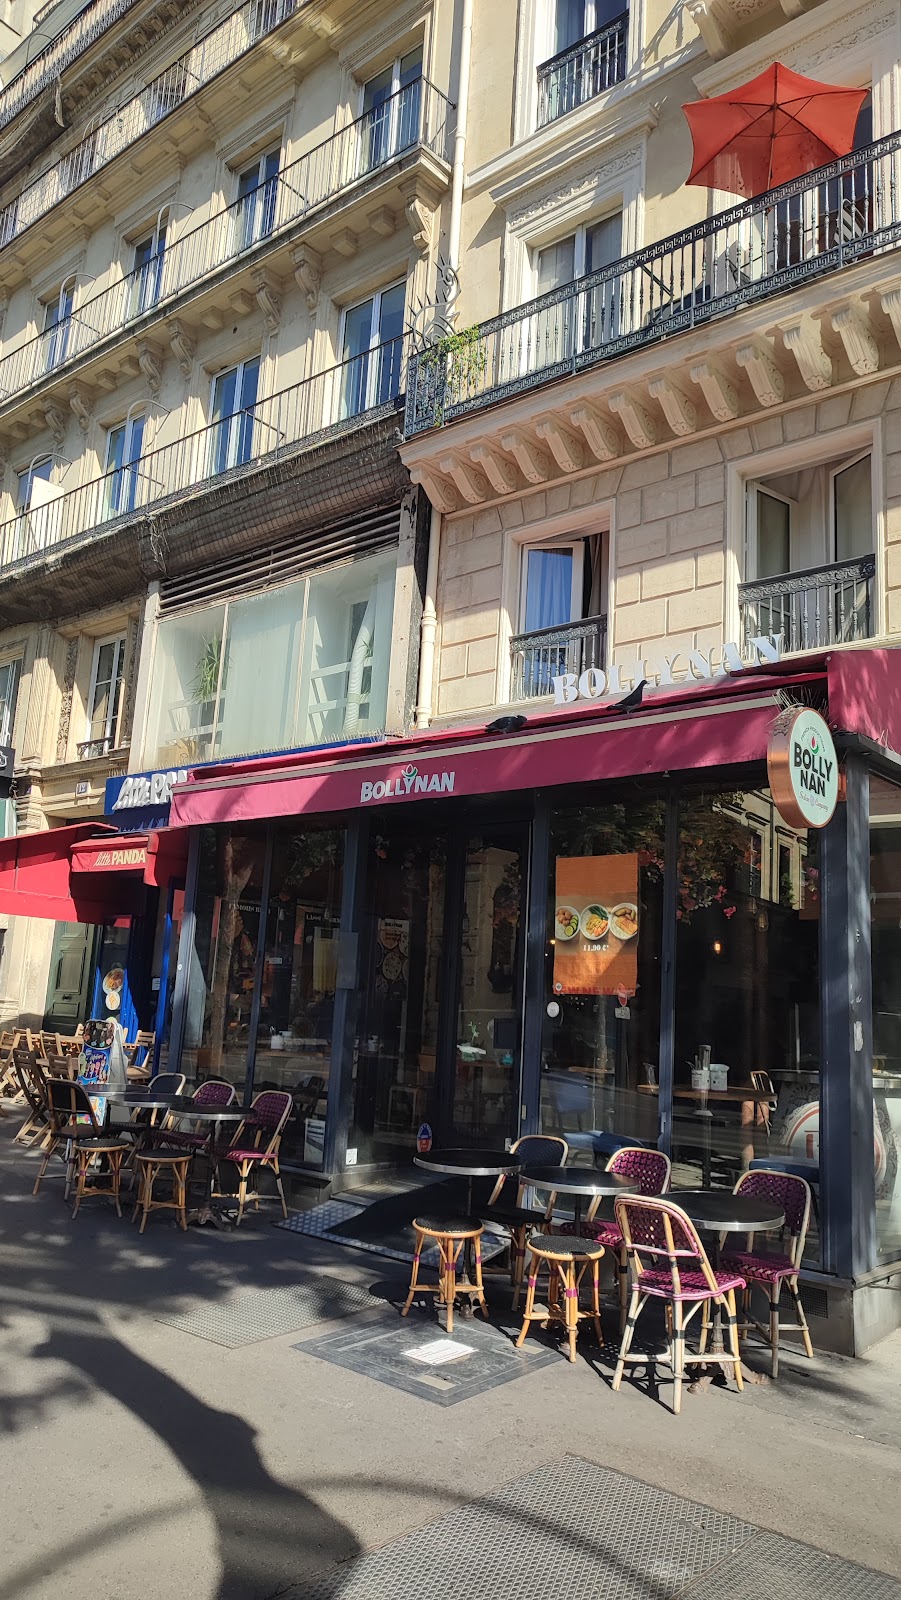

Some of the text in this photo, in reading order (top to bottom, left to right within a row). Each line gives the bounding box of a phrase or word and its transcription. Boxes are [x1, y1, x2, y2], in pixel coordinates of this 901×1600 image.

[552, 633, 785, 705] BOLLYNAN
[794, 742, 833, 782] BOLLY
[360, 771, 455, 803] BOLLYNAN
[800, 769, 826, 798] NAN
[94, 849, 145, 867] little PANDA
[583, 944, 600, 952] 11.90
